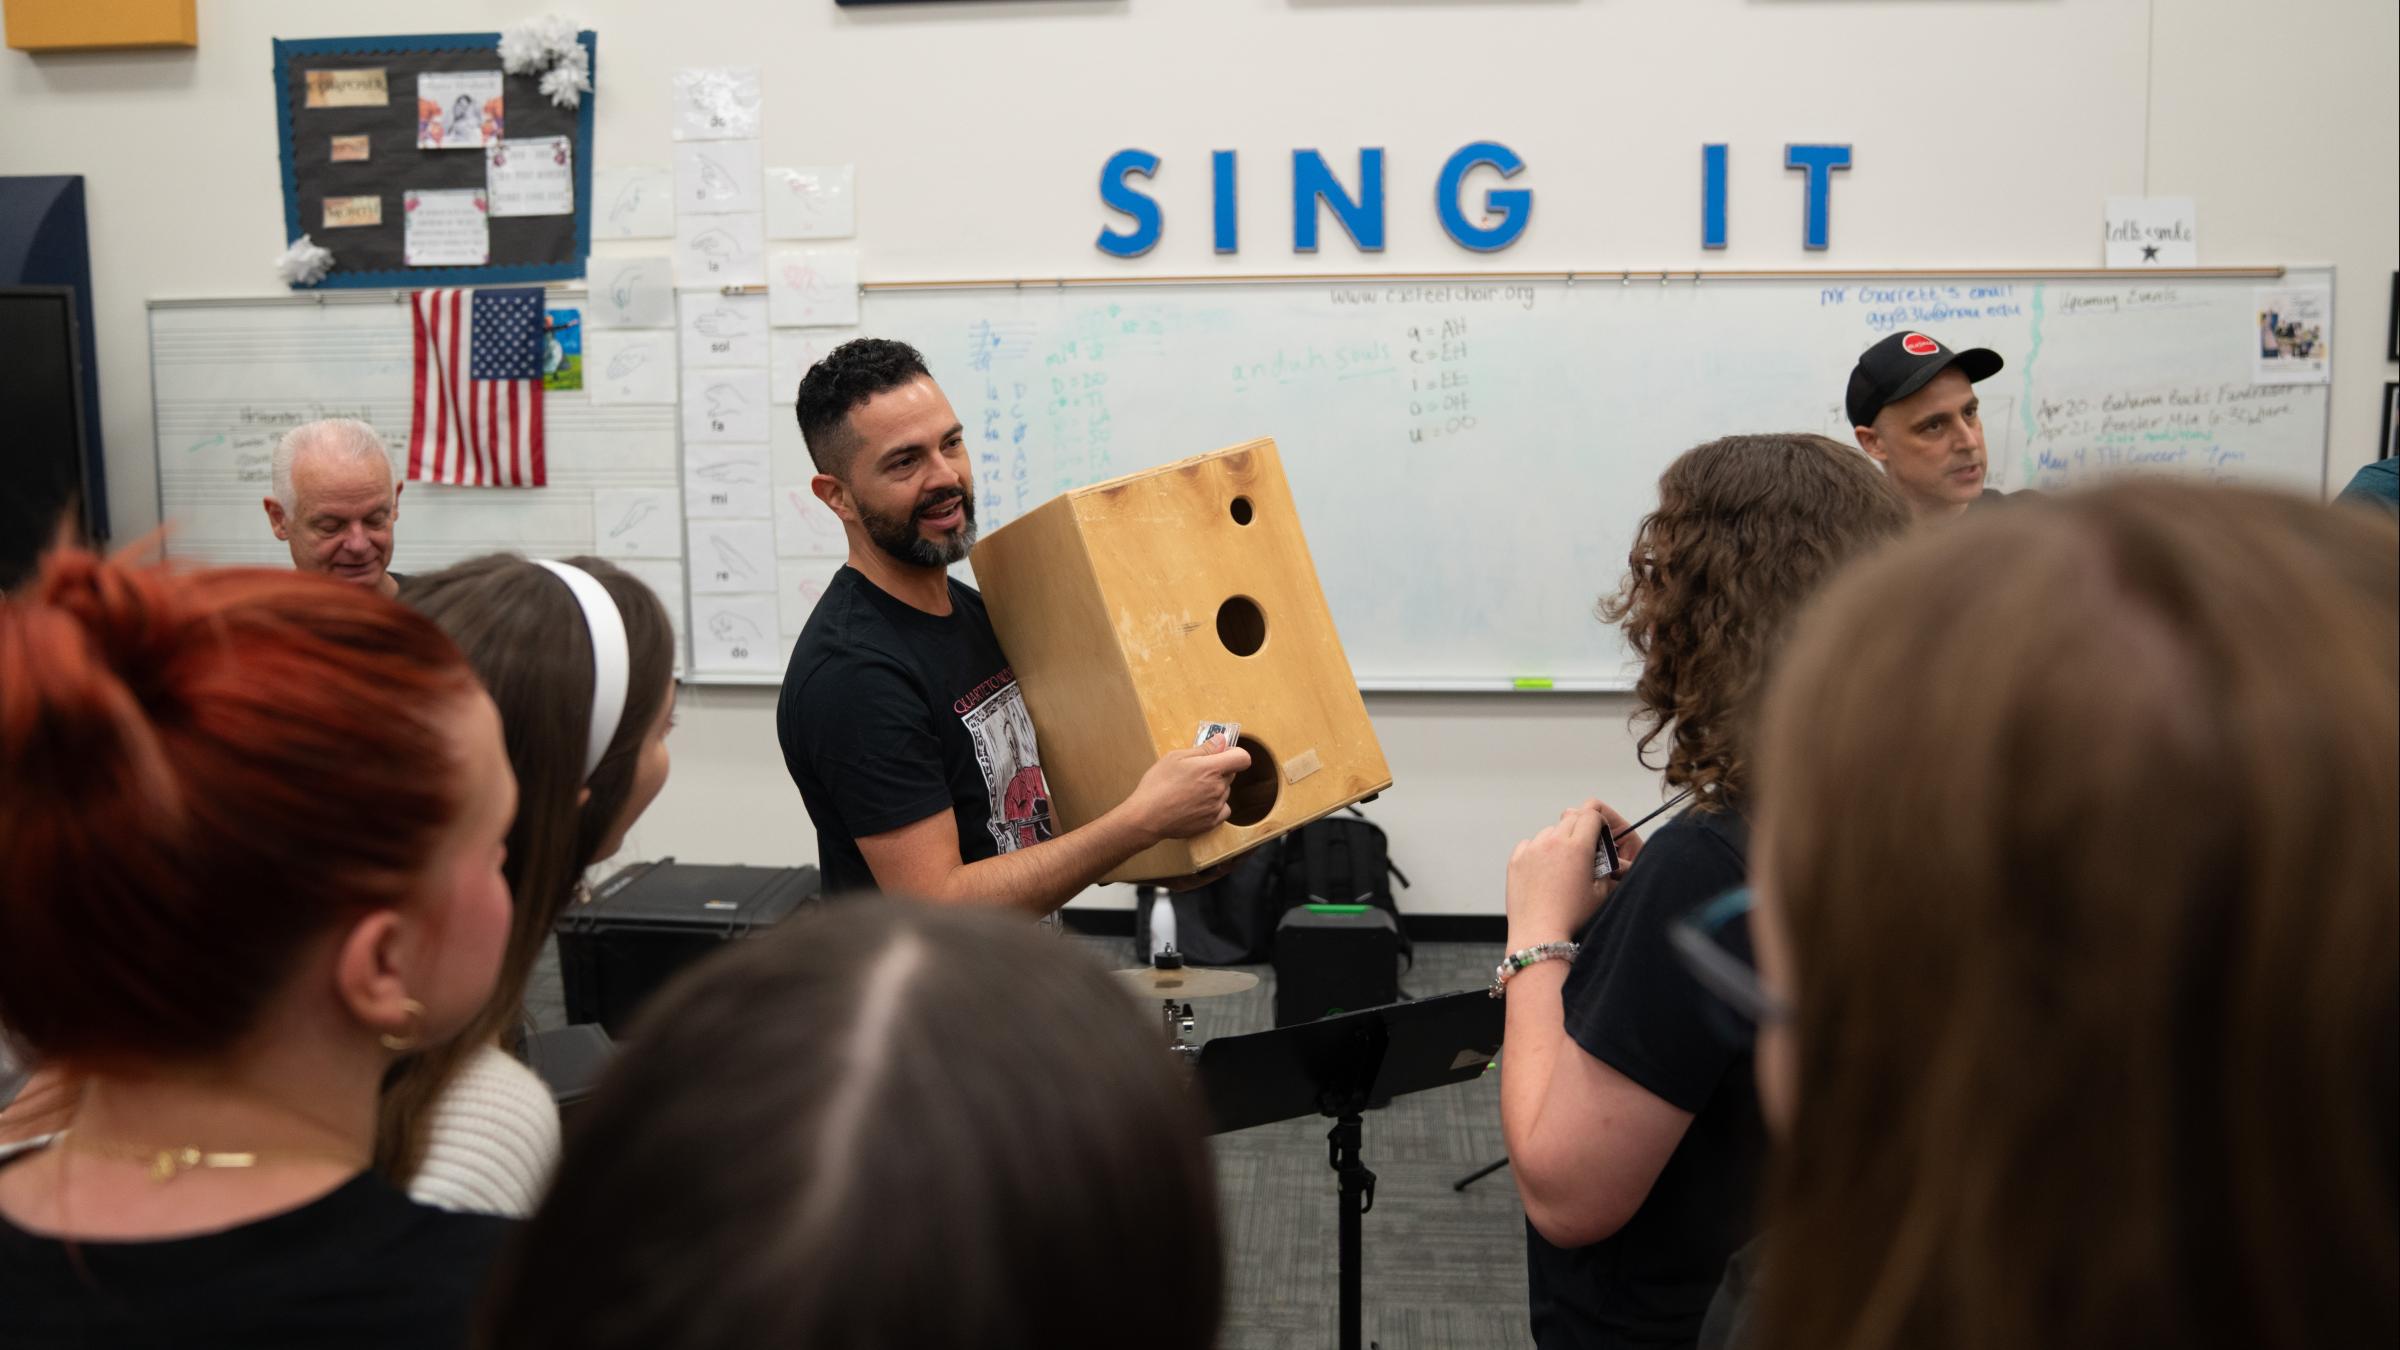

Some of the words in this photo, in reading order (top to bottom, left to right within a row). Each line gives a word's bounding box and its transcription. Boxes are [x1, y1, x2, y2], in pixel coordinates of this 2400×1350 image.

[1096, 140, 1533, 258] SING
[1701, 143, 1853, 250] IT
[711, 492, 727, 504] mi
[716, 571, 729, 582] re
[731, 648, 748, 658] do
